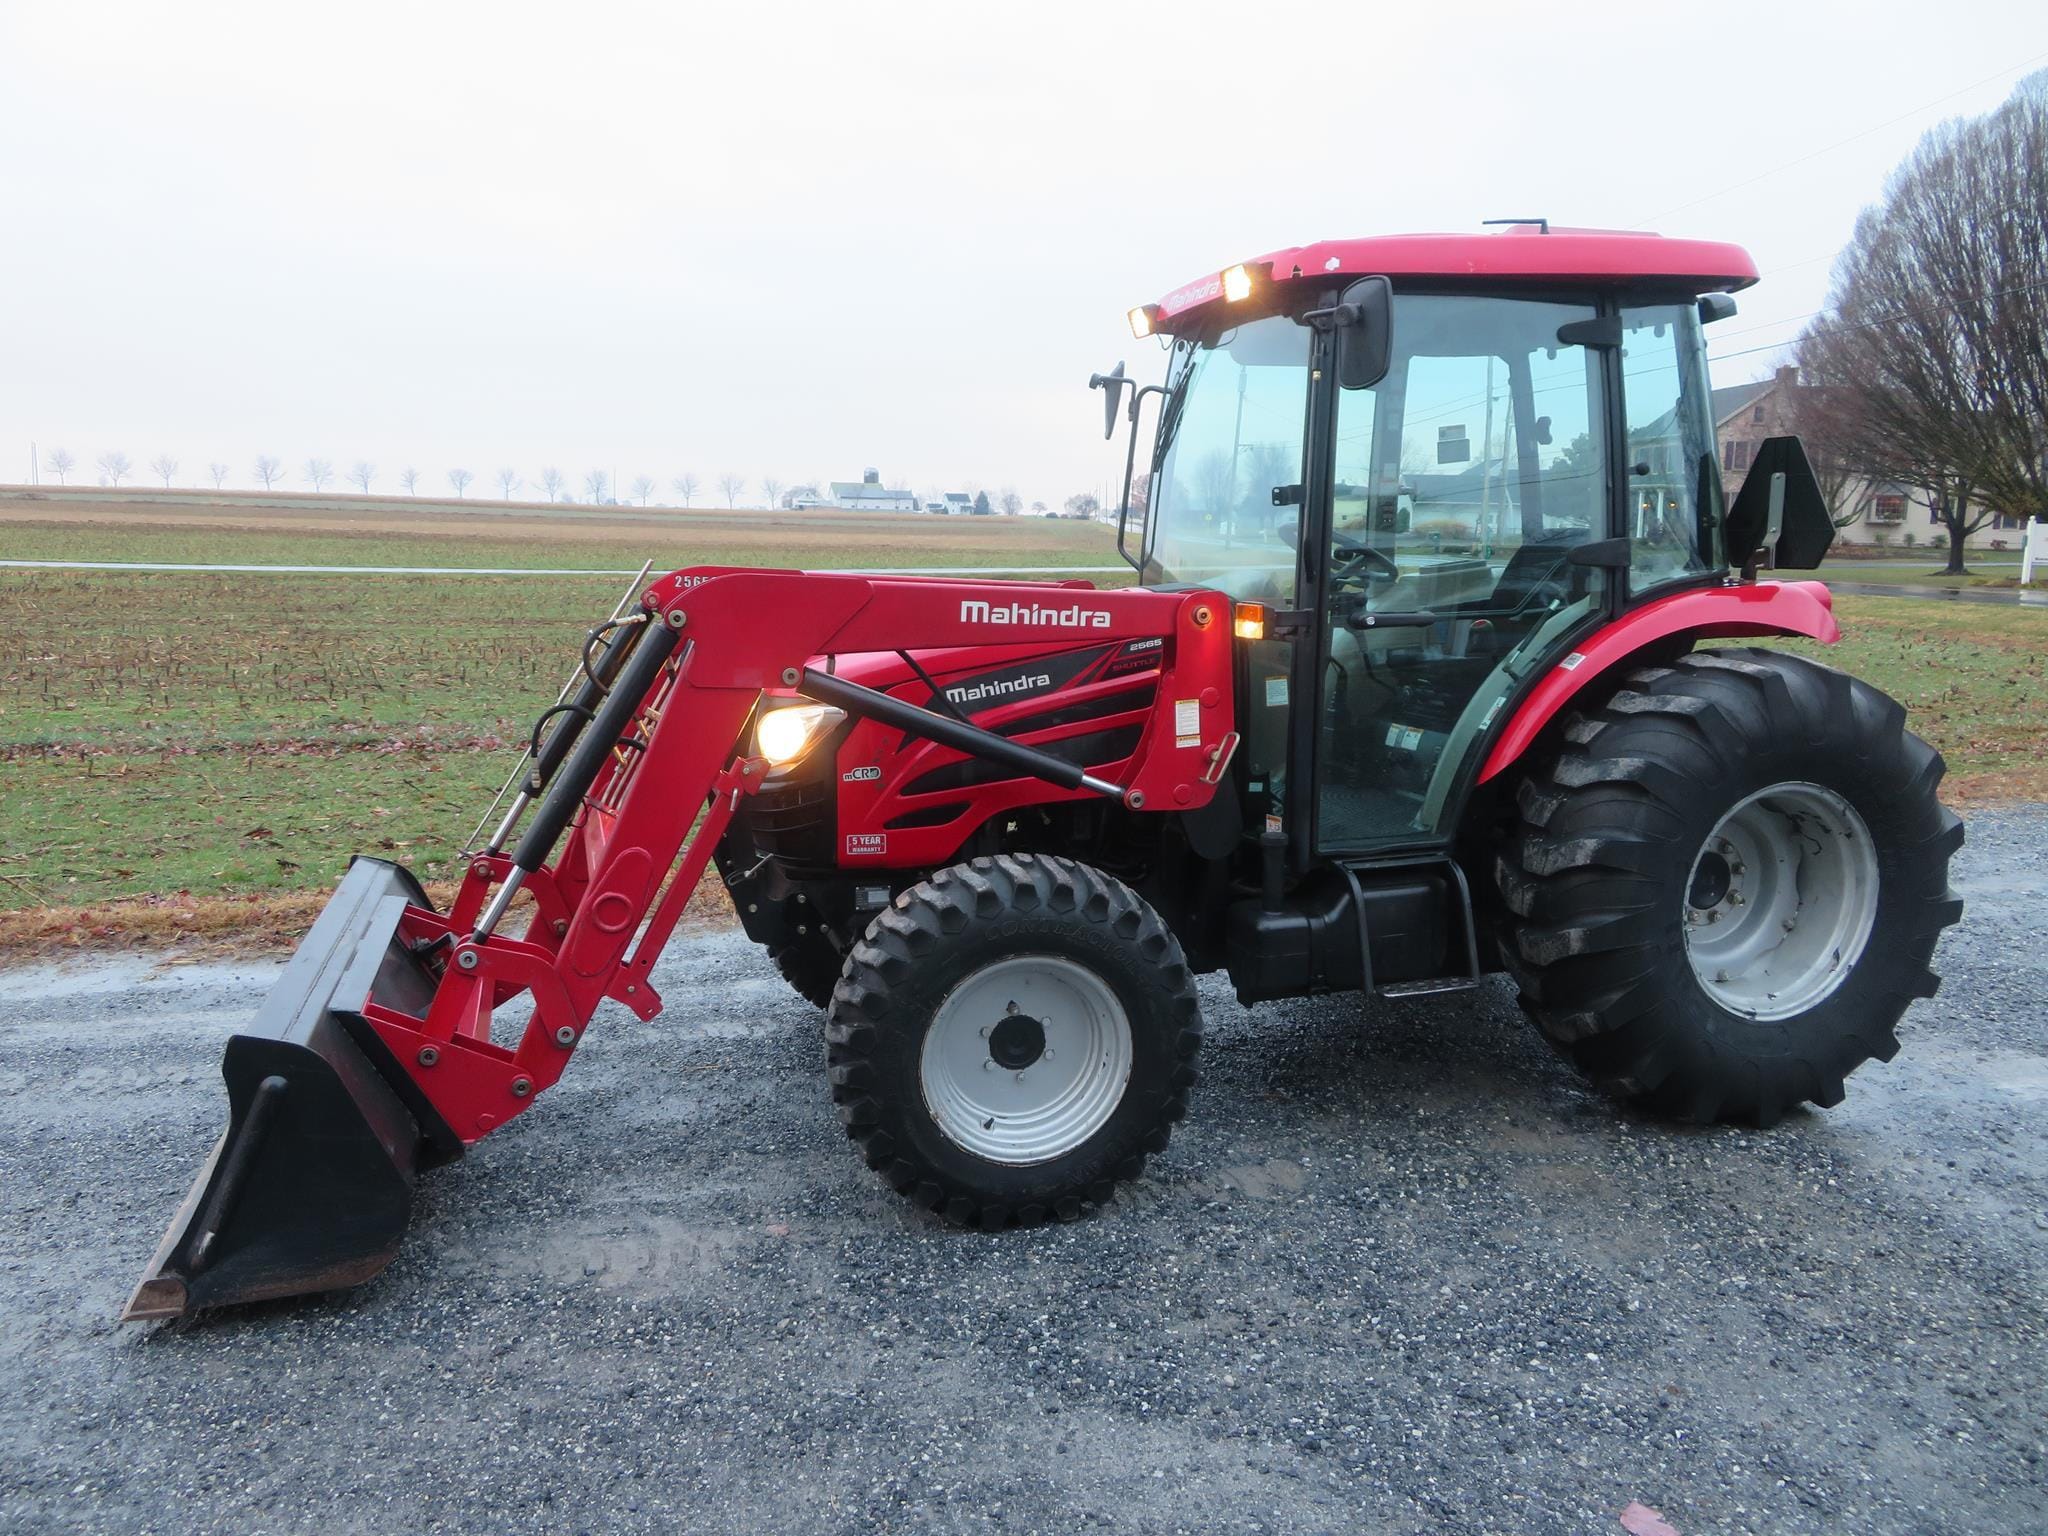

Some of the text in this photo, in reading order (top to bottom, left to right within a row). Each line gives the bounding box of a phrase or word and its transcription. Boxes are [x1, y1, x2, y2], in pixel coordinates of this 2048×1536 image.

[960, 600, 1111, 628] Mahindra
[1130, 638, 1162, 651] 2565
[946, 673, 1050, 703] Mahindra
[852, 836, 881, 845] 5 YEAR
